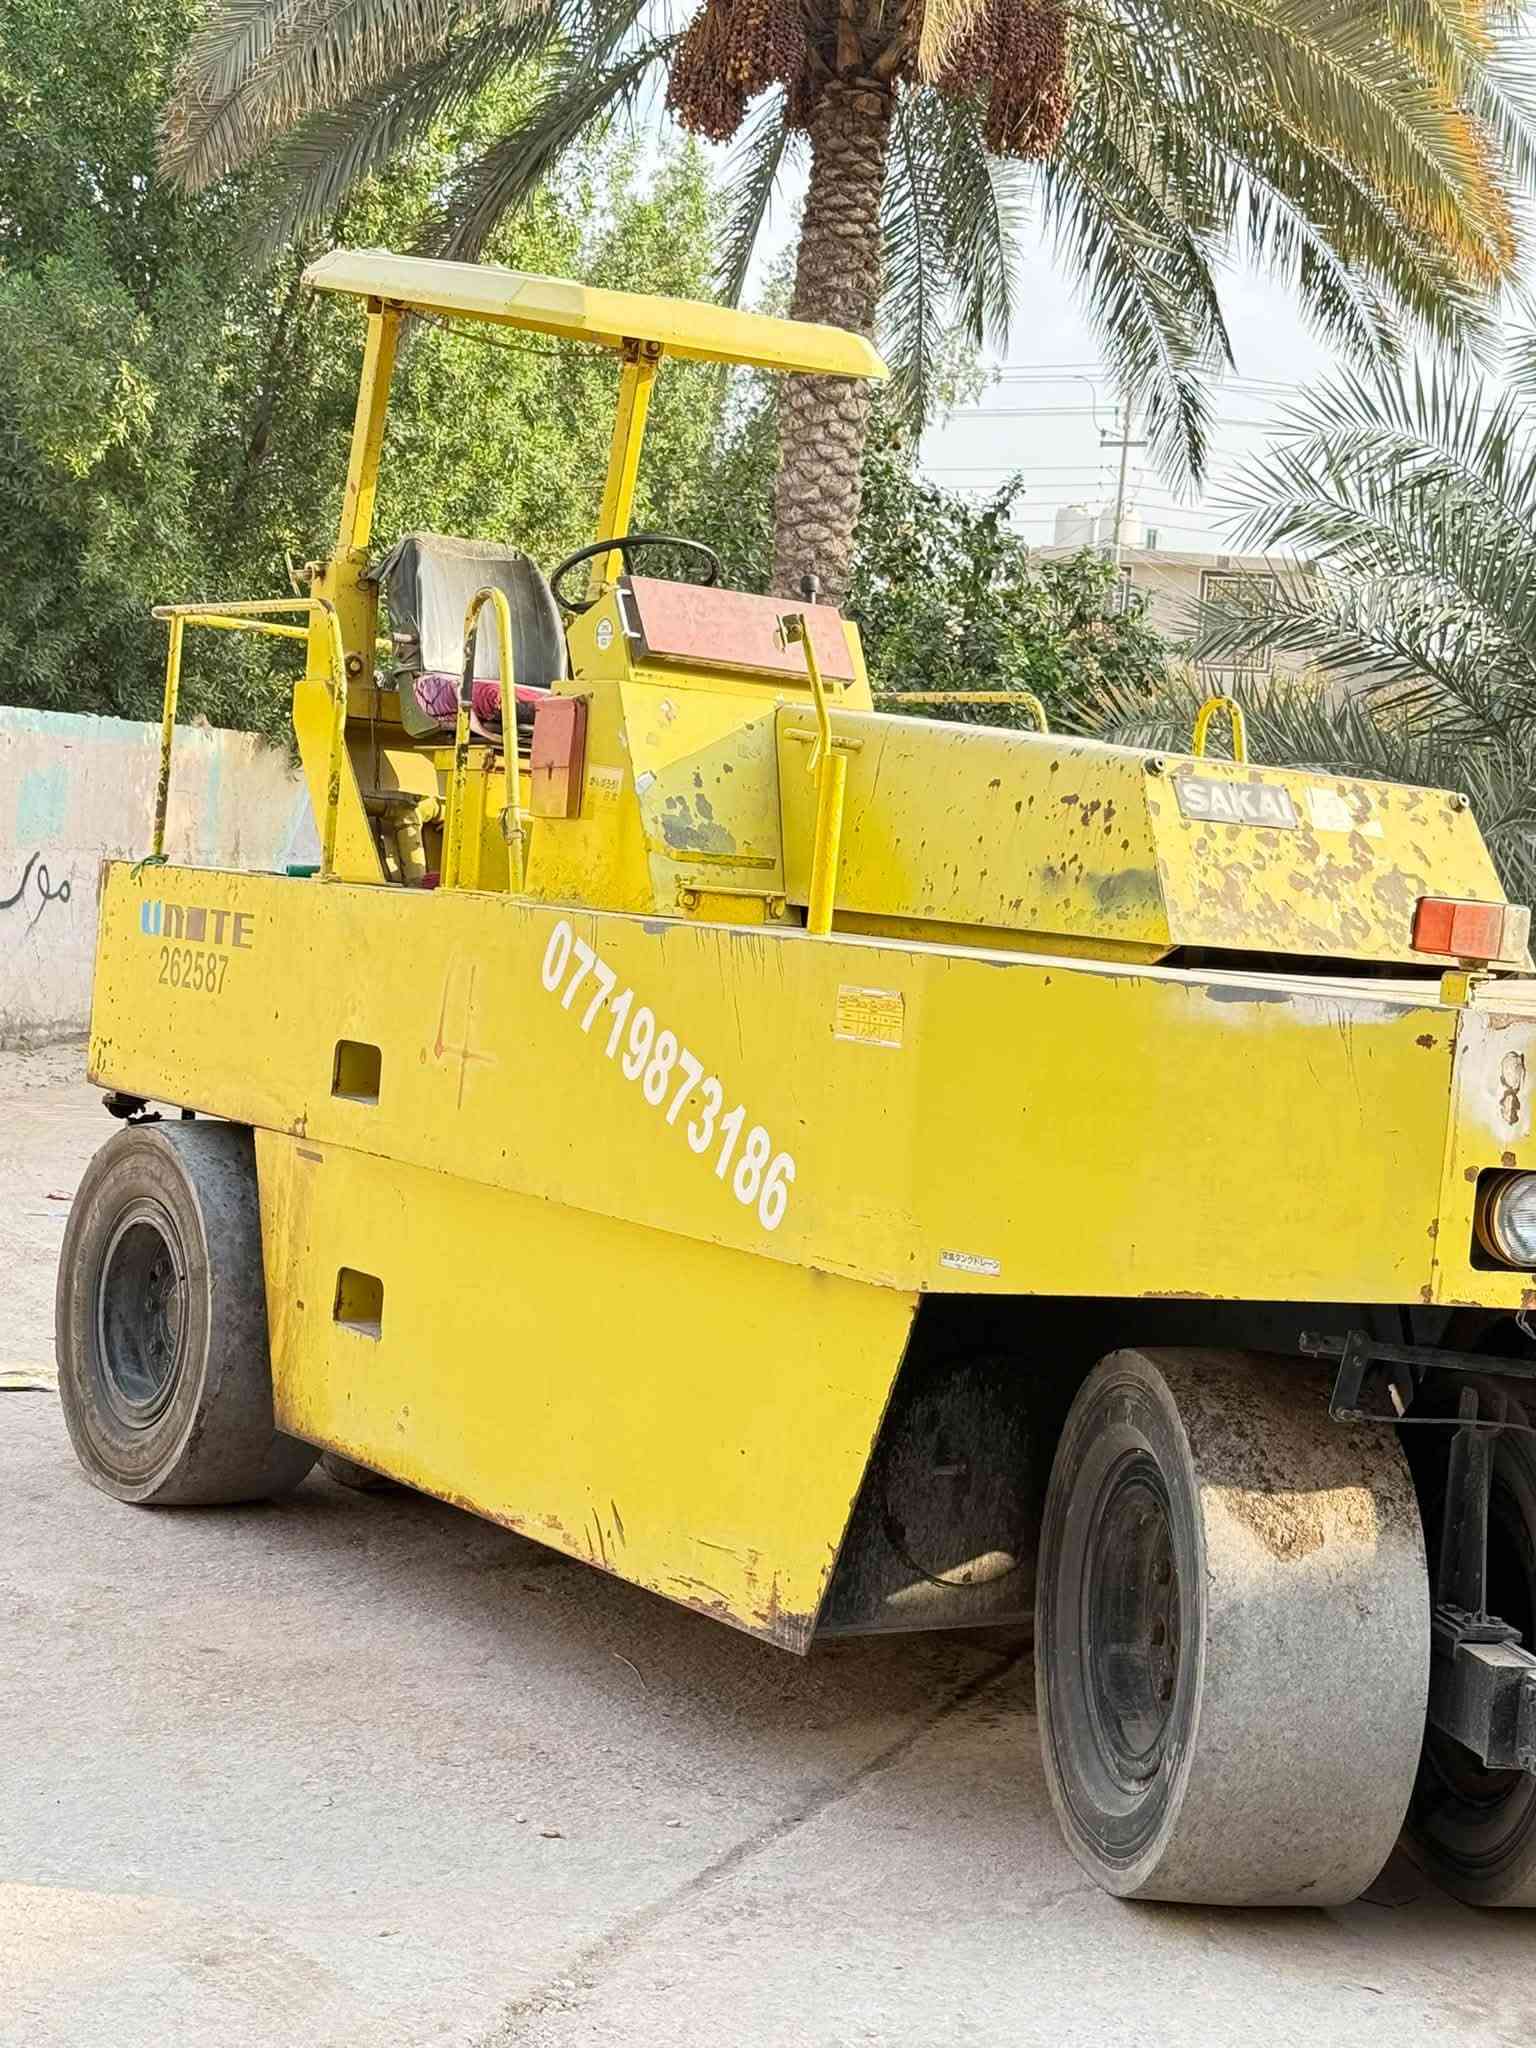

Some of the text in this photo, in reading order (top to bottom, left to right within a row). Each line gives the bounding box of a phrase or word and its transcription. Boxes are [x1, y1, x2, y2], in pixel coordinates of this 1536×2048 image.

[1183, 782, 1293, 820] SAKAI
[158, 944, 229, 995] 262587
[541, 919, 796, 1232] 07719873186
